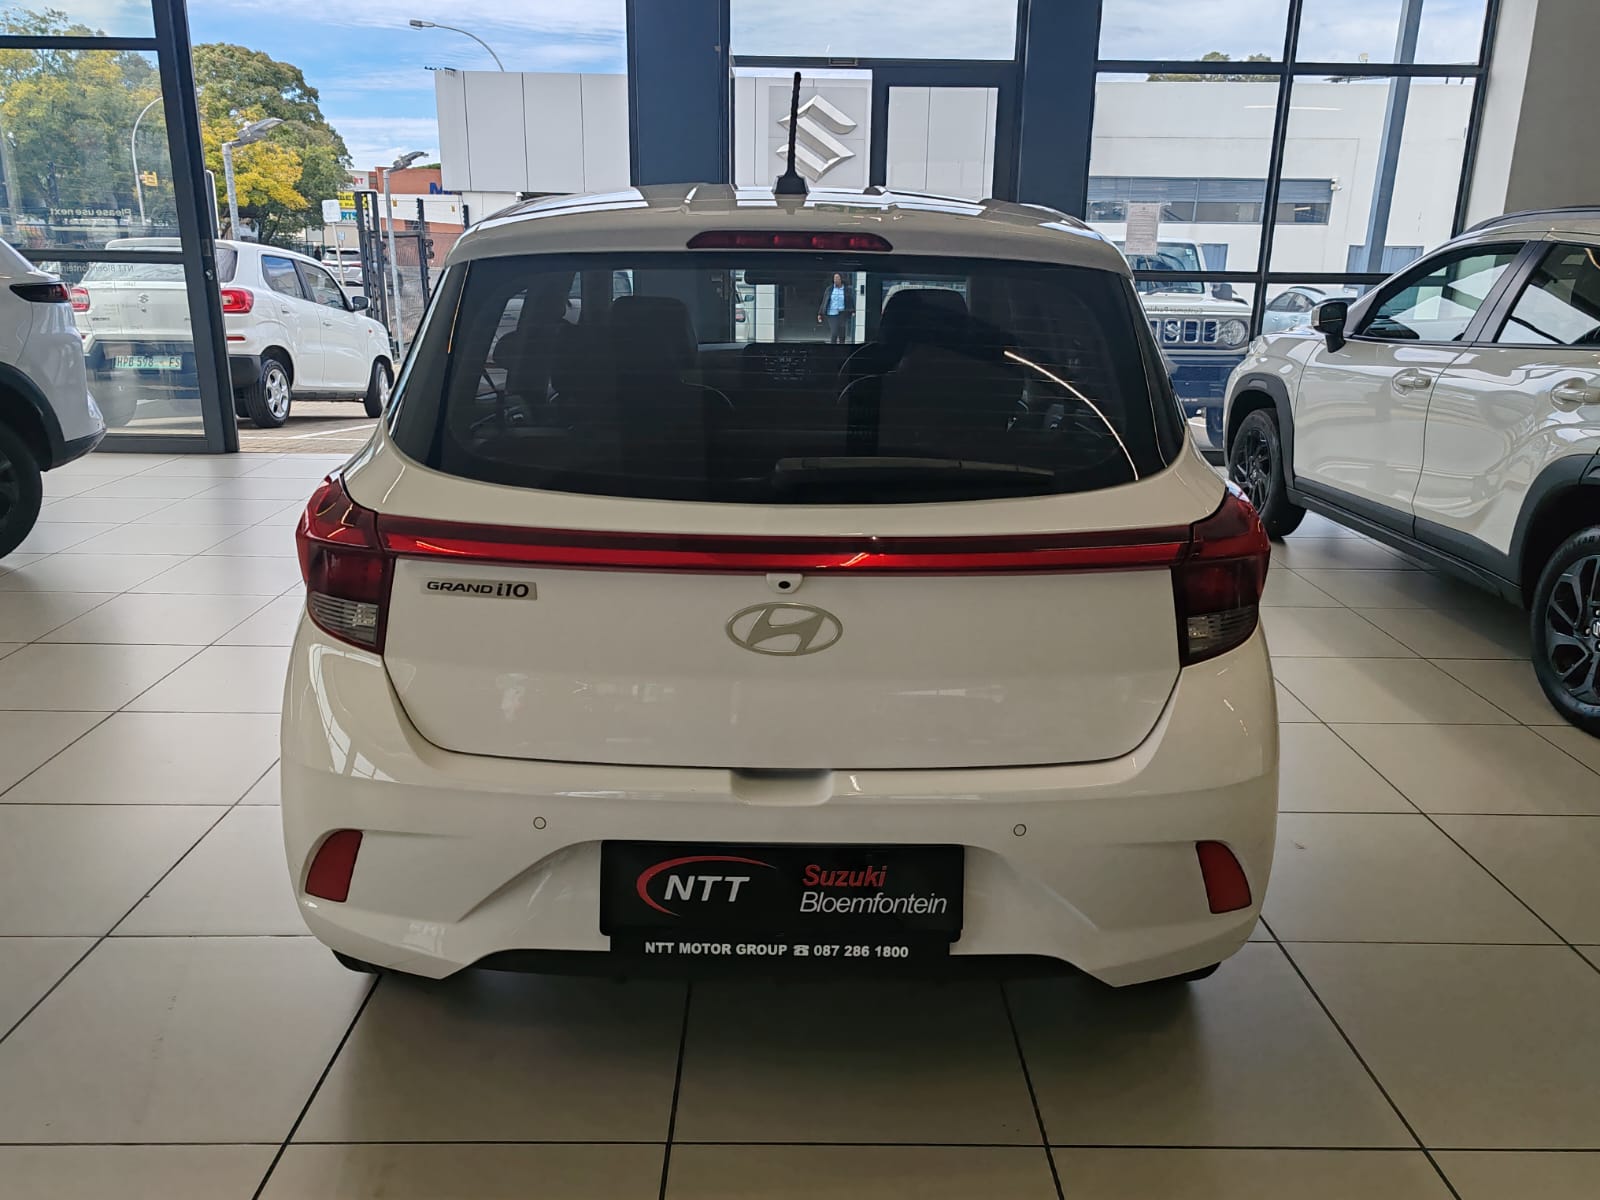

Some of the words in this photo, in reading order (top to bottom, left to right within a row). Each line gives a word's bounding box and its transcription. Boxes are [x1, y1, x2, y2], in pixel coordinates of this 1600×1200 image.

[169, 357, 181, 367] FS
[426, 581, 493, 594] GRAND
[497, 583, 530, 598] i10
[802, 864, 888, 888] Suzuki
[664, 874, 750, 902] NTT
[799, 891, 948, 914] Bloemfontein
[645, 942, 675, 954] NTT
[679, 943, 732, 955] MOTOR
[736, 943, 788, 956] GROUP
[813, 944, 840, 957] 087
[844, 945, 870, 957] 286
[874, 946, 909, 958] 1800
